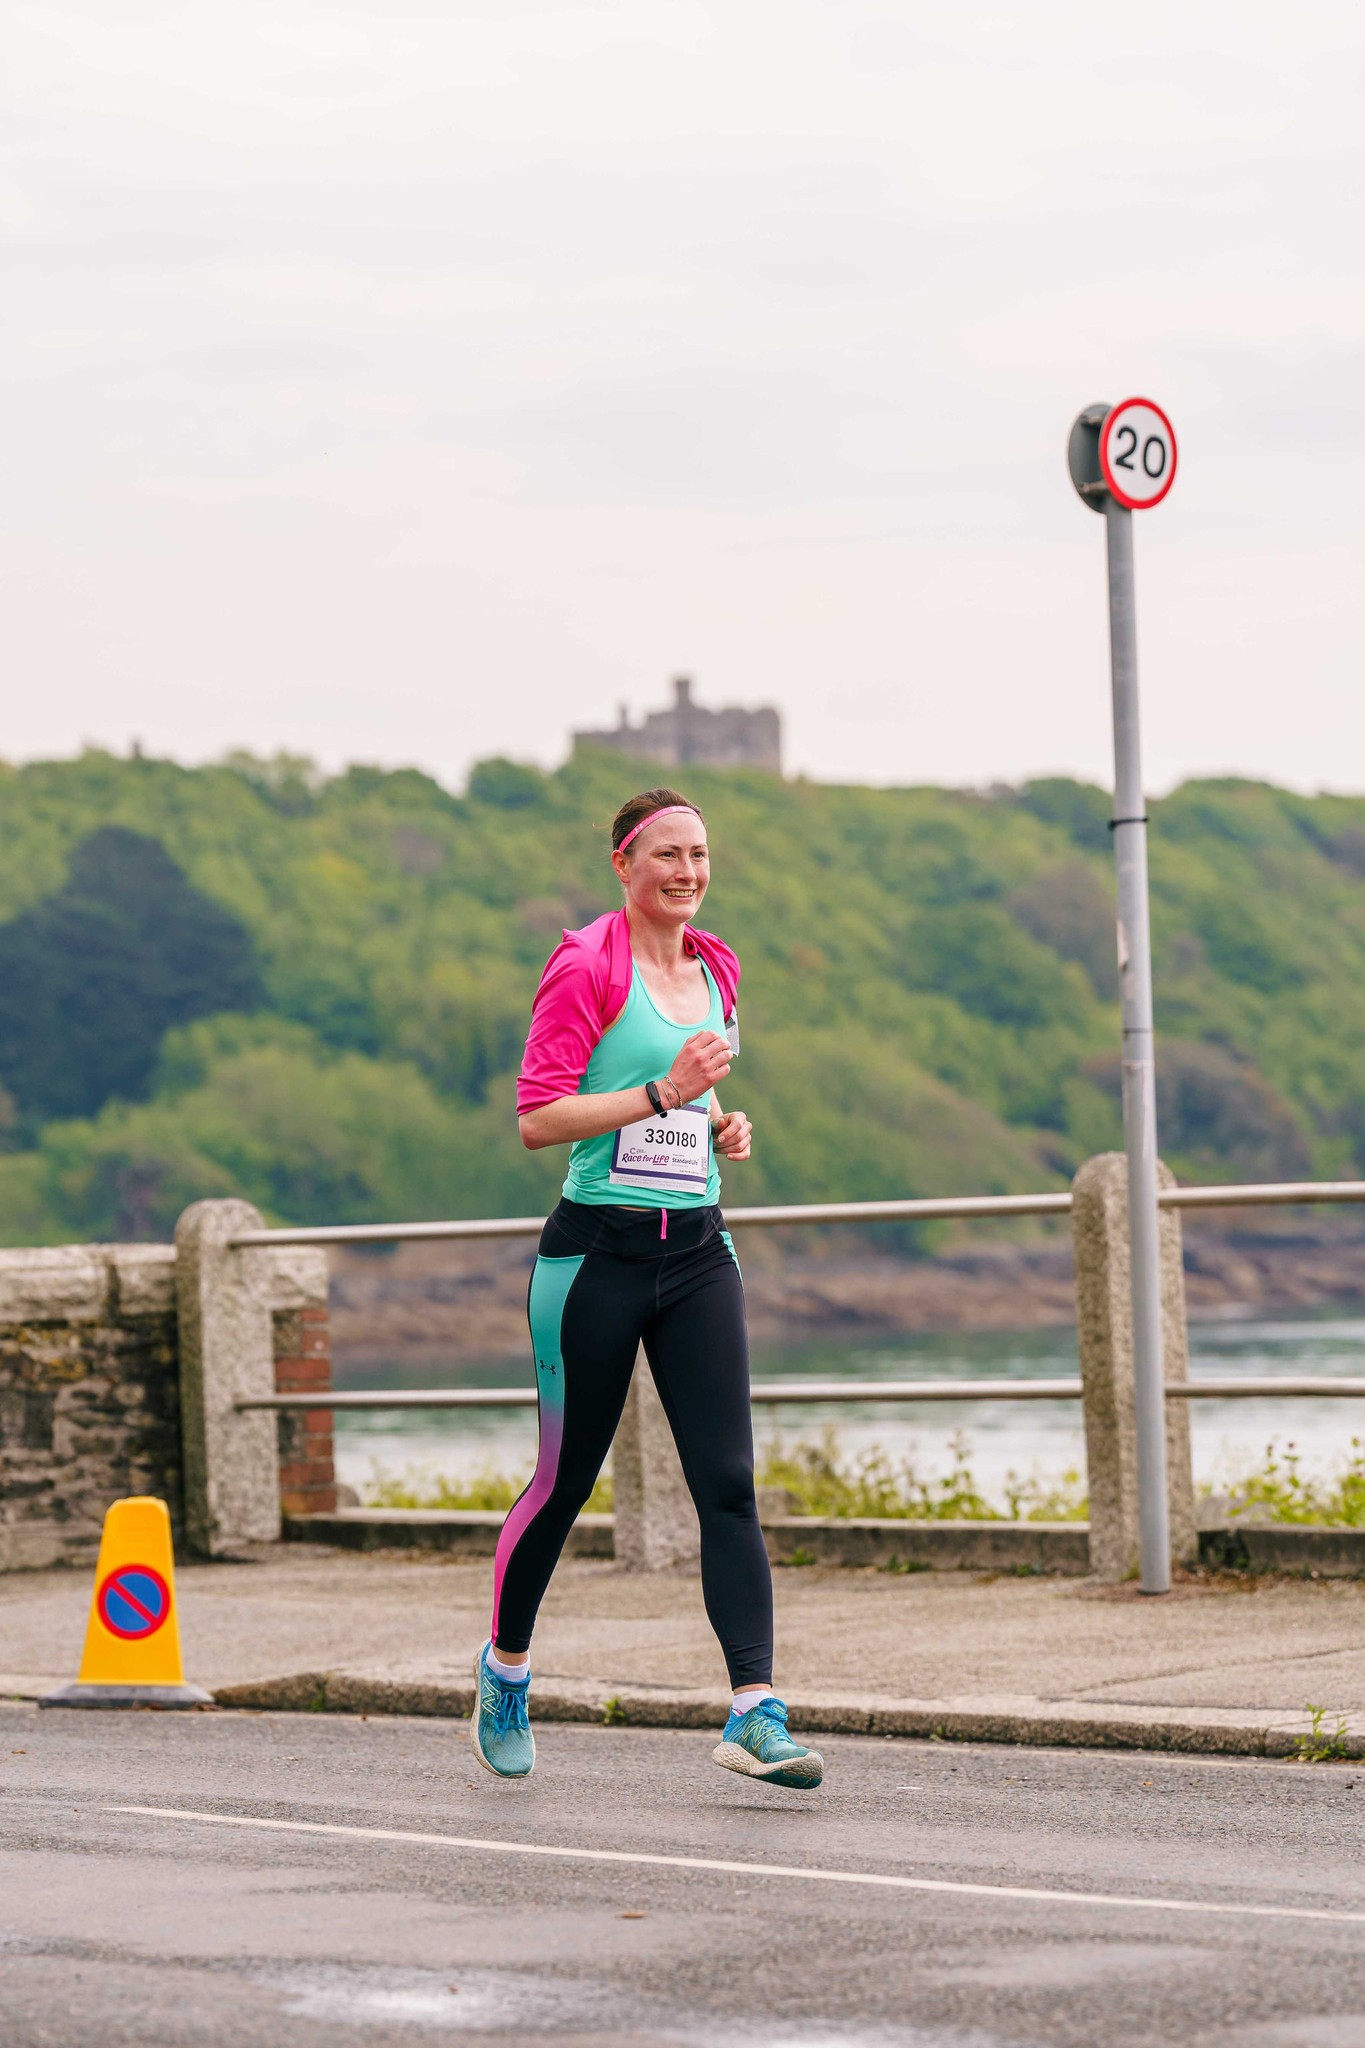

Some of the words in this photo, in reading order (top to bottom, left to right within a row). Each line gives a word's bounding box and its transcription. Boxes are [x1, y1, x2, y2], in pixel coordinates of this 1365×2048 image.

[1115, 426, 1166, 478] 20
[644, 1128, 697, 1148] 330180
[621, 1153, 642, 1163] Race
[642, 1154, 653, 1162] for
[652, 1154, 670, 1163] Life
